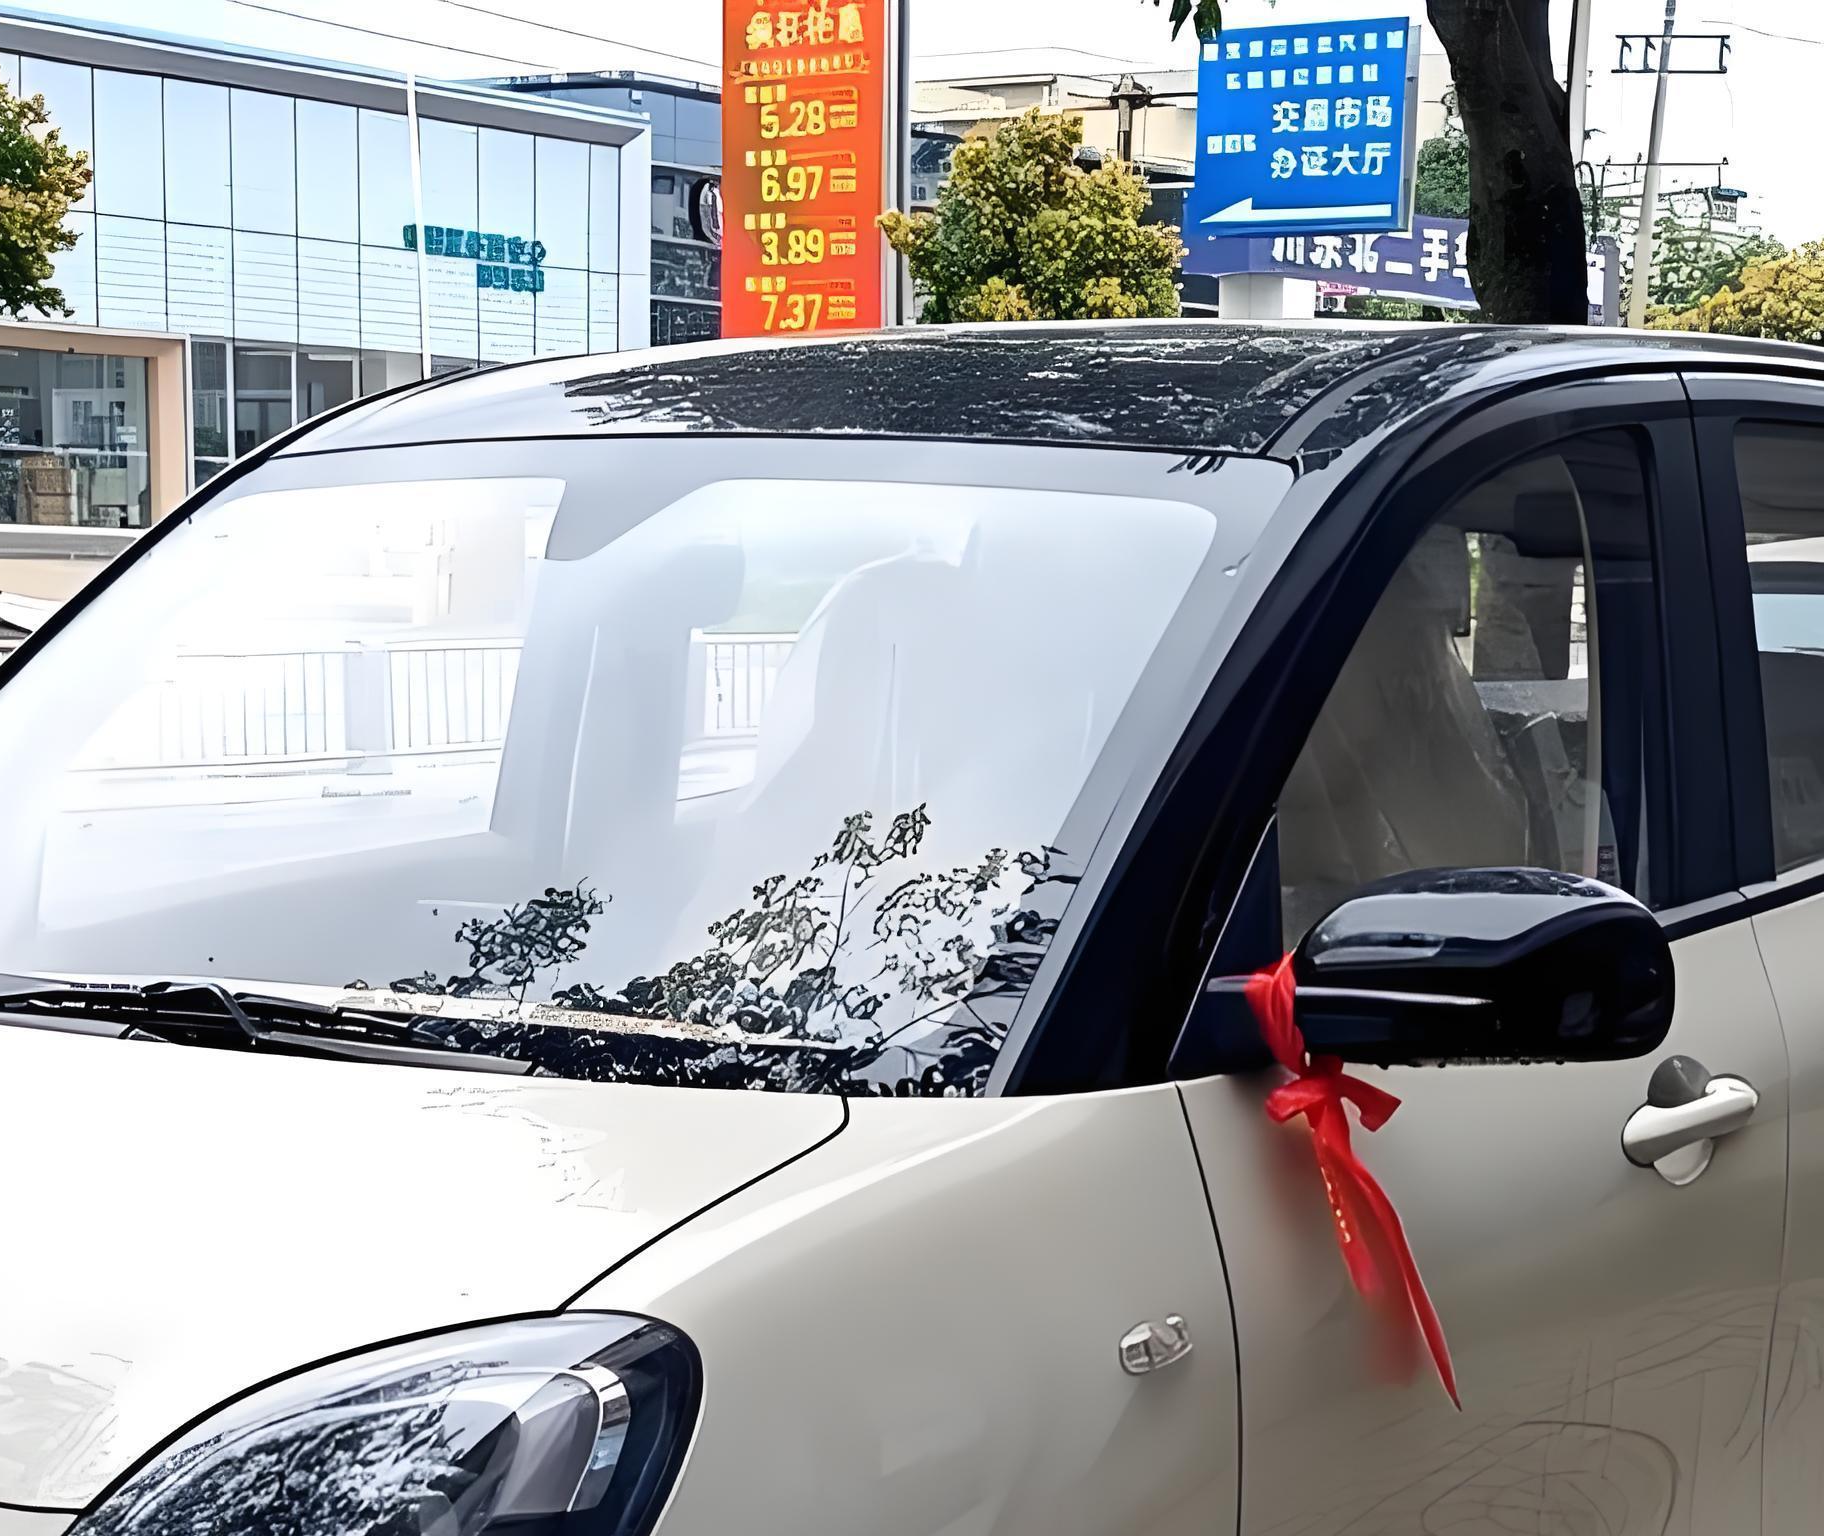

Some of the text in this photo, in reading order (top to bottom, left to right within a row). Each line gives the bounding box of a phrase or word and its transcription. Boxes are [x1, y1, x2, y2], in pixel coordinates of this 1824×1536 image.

[760, 100, 825, 139] 5.28
[761, 165, 823, 202] 6.97
[761, 229, 824, 266] 3.89
[760, 293, 823, 331] 7.37
